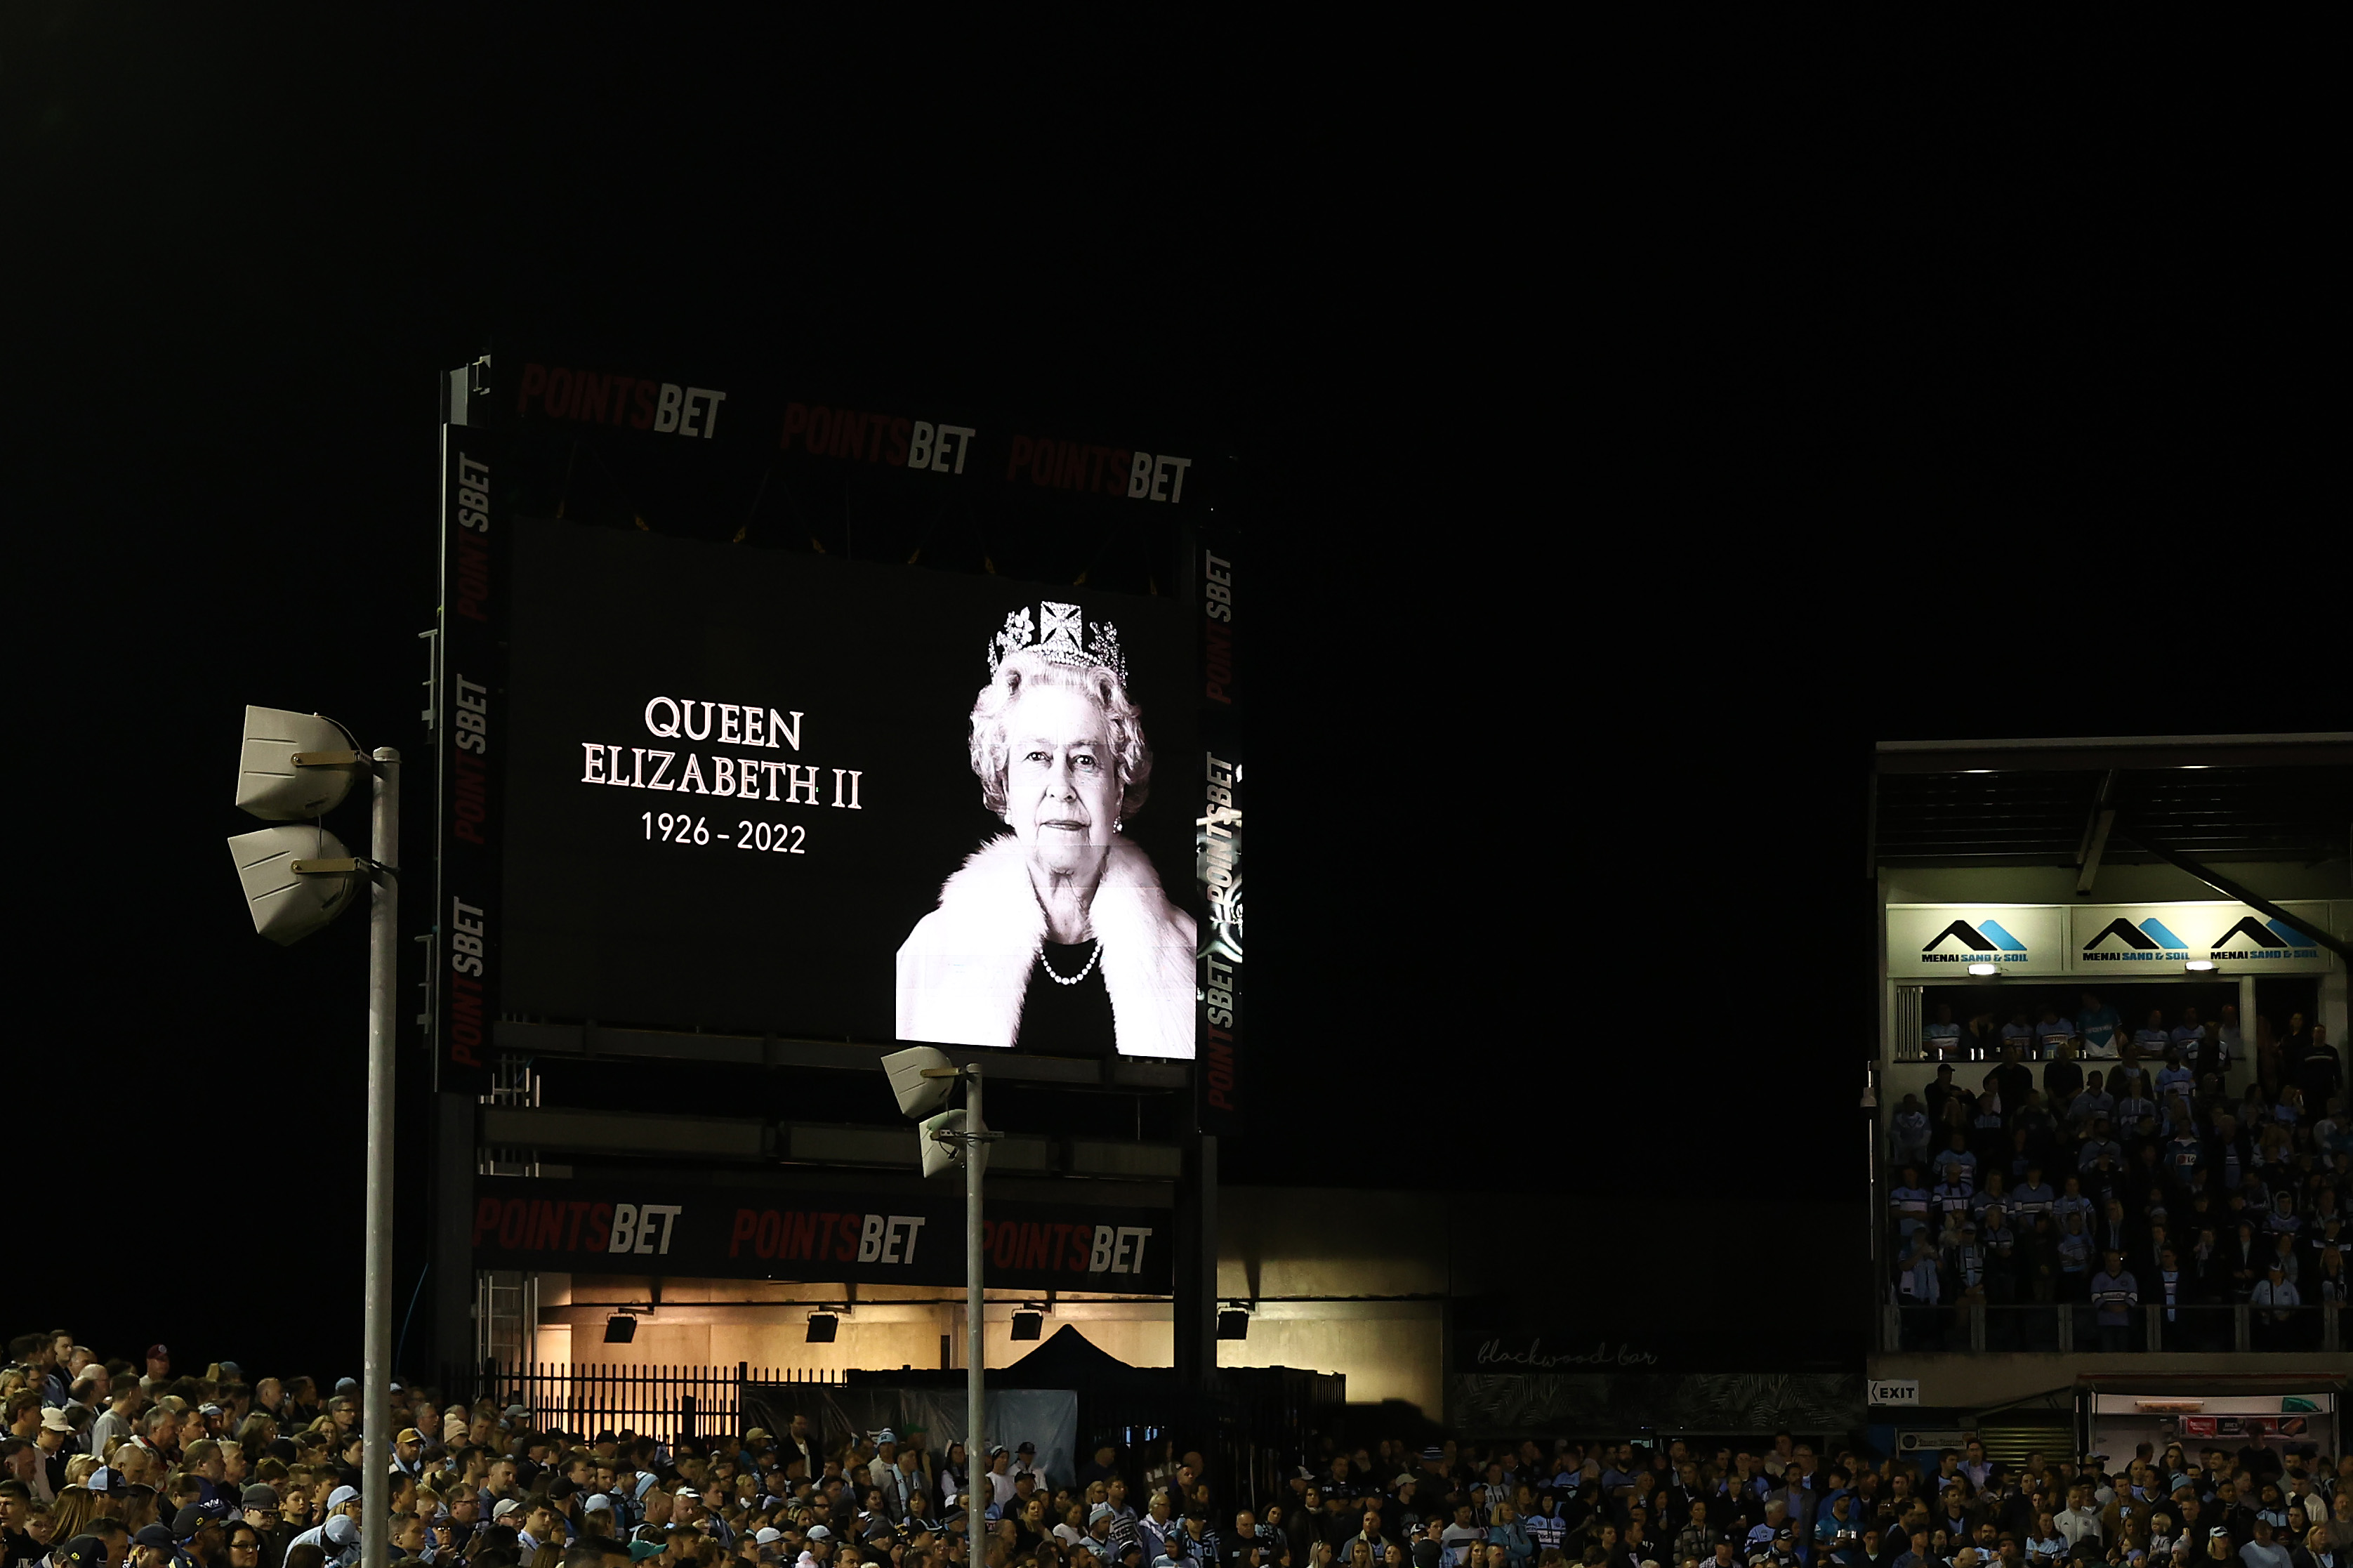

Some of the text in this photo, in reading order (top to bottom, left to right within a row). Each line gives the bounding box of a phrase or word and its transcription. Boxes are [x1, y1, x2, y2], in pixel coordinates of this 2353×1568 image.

[516, 362, 727, 439] POINTSBET
[779, 401, 976, 475] POINTSBET
[1006, 434, 1192, 504] POINTSBET
[456, 452, 489, 623] POINTSBET
[1205, 549, 1232, 704] POINTSBET
[645, 695, 805, 751] QUEEN
[453, 673, 487, 844] POINTSBET
[581, 742, 864, 810] ELIZABETH II
[641, 811, 710, 845] 1926
[737, 820, 806, 855] 2022
[1206, 751, 1233, 904] POINTSBET
[452, 895, 484, 1067] POINTSBET
[1921, 954, 2028, 962] MENAI SAND & SOIL
[2083, 952, 2121, 961] MENAI
[2122, 952, 2153, 961] SAND
[2210, 951, 2248, 960] MENAI
[2250, 950, 2281, 959] SAND
[2293, 950, 2319, 958] SOIL
[1207, 956, 1234, 1112] POINTSBET
[472, 1197, 683, 1255] POINTSBET
[730, 1207, 925, 1265] POINTSBET
[1477, 1338, 1658, 1367] blackwood bar
[1880, 1388, 1915, 1398] EXIT
